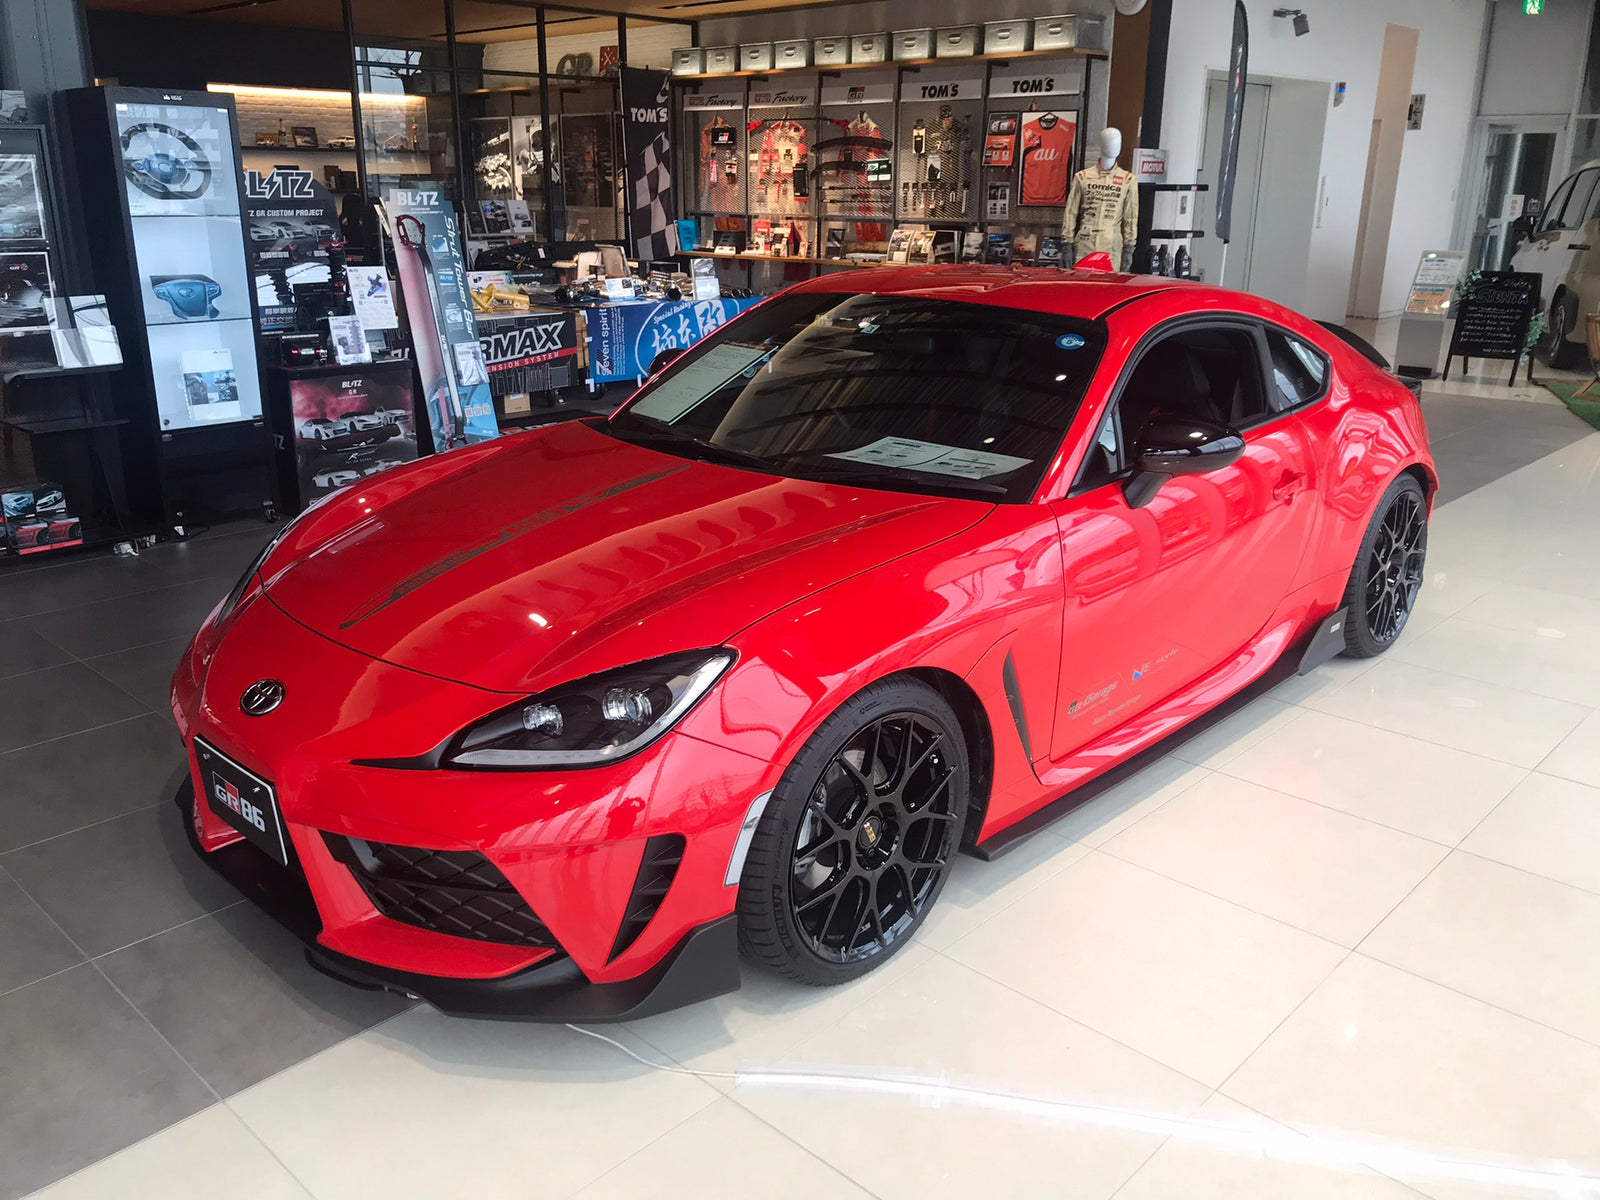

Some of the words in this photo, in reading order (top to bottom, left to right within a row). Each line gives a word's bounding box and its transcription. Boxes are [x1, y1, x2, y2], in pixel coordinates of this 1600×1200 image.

[921, 83, 959, 98] TOM'S
[1012, 77, 1055, 94] TOM'S
[705, 95, 737, 107] Factory
[772, 91, 807, 104] Factory
[630, 107, 669, 123] TOM'S
[1034, 148, 1059, 161] au
[245, 168, 314, 199] LITZ
[1087, 183, 1121, 192] tomica
[397, 191, 439, 206] BLITZ
[267, 209, 295, 217] CUSTOM
[295, 209, 325, 217] PROJECT
[479, 321, 566, 365] RMAX
[487, 360, 520, 373] ENSION
[524, 352, 560, 365] SYSTEM
[341, 379, 363, 389] BLITZ
[215, 783, 266, 832] GR86
